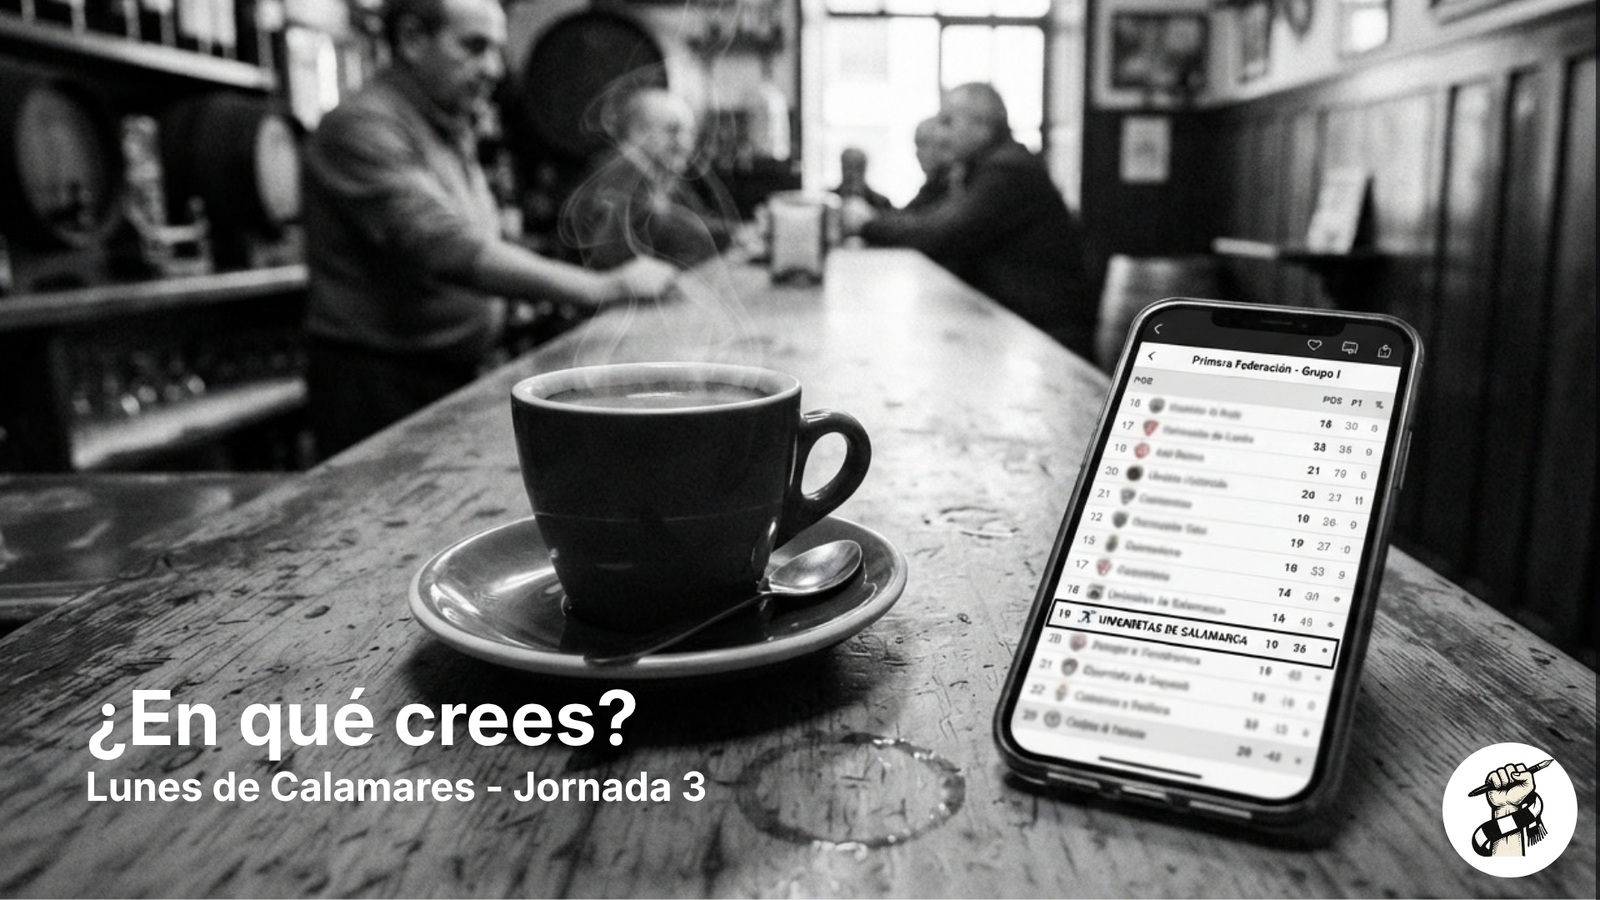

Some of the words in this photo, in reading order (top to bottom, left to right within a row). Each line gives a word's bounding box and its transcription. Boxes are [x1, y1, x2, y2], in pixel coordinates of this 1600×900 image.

[1301, 365, 1334, 379] Grupo
[1344, 421, 1359, 431] 30
[1306, 465, 1321, 476] 21
[1096, 488, 1111, 498] 21
[1265, 639, 1279, 650] 10
